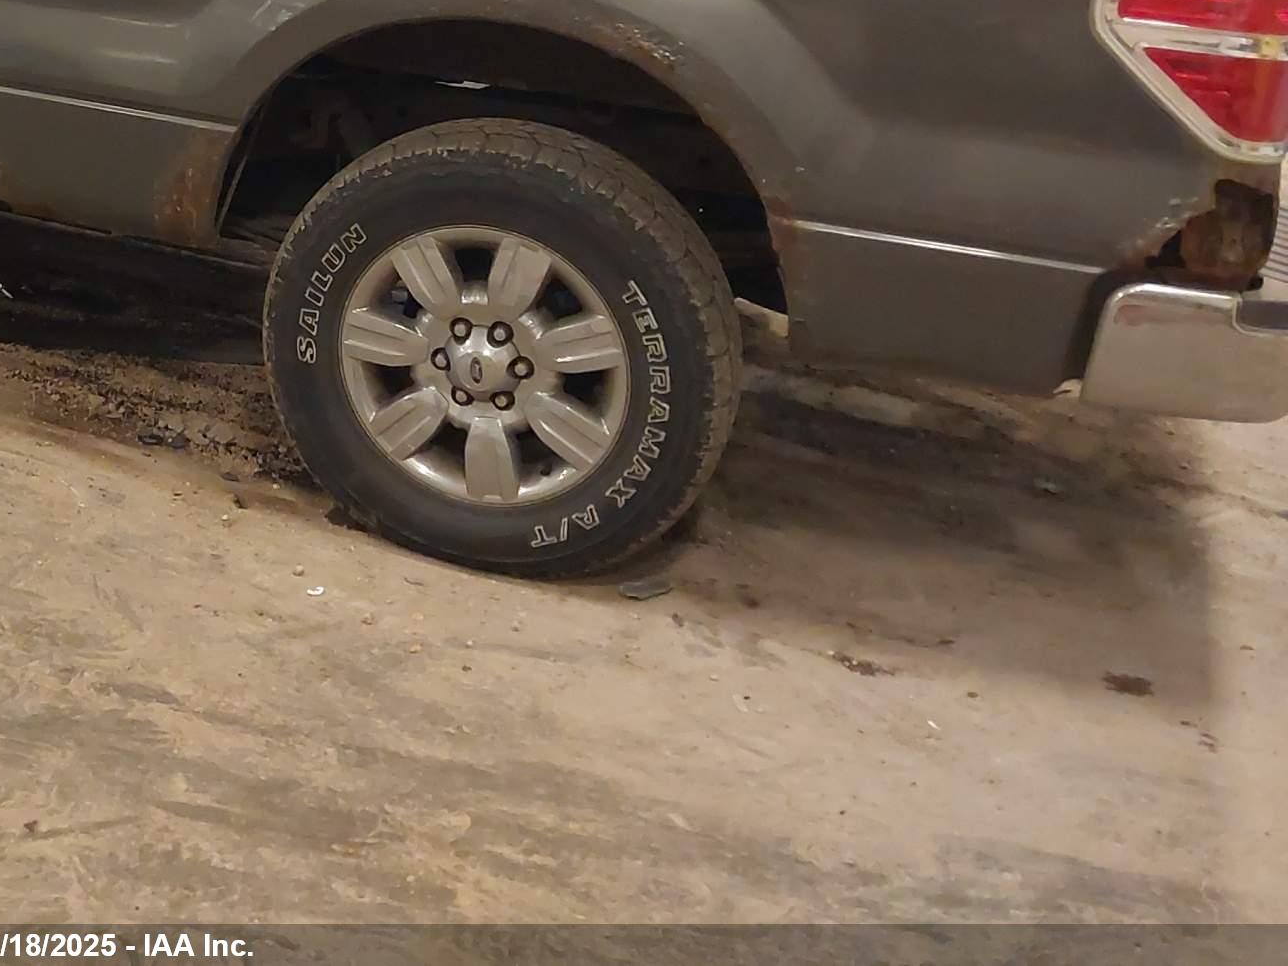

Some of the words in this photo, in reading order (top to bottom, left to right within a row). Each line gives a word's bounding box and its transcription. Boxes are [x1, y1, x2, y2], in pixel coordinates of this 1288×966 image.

[297, 222, 367, 364] SAILUN
[605, 280, 671, 509] TERRAMAX
[530, 503, 600, 548] A/T
